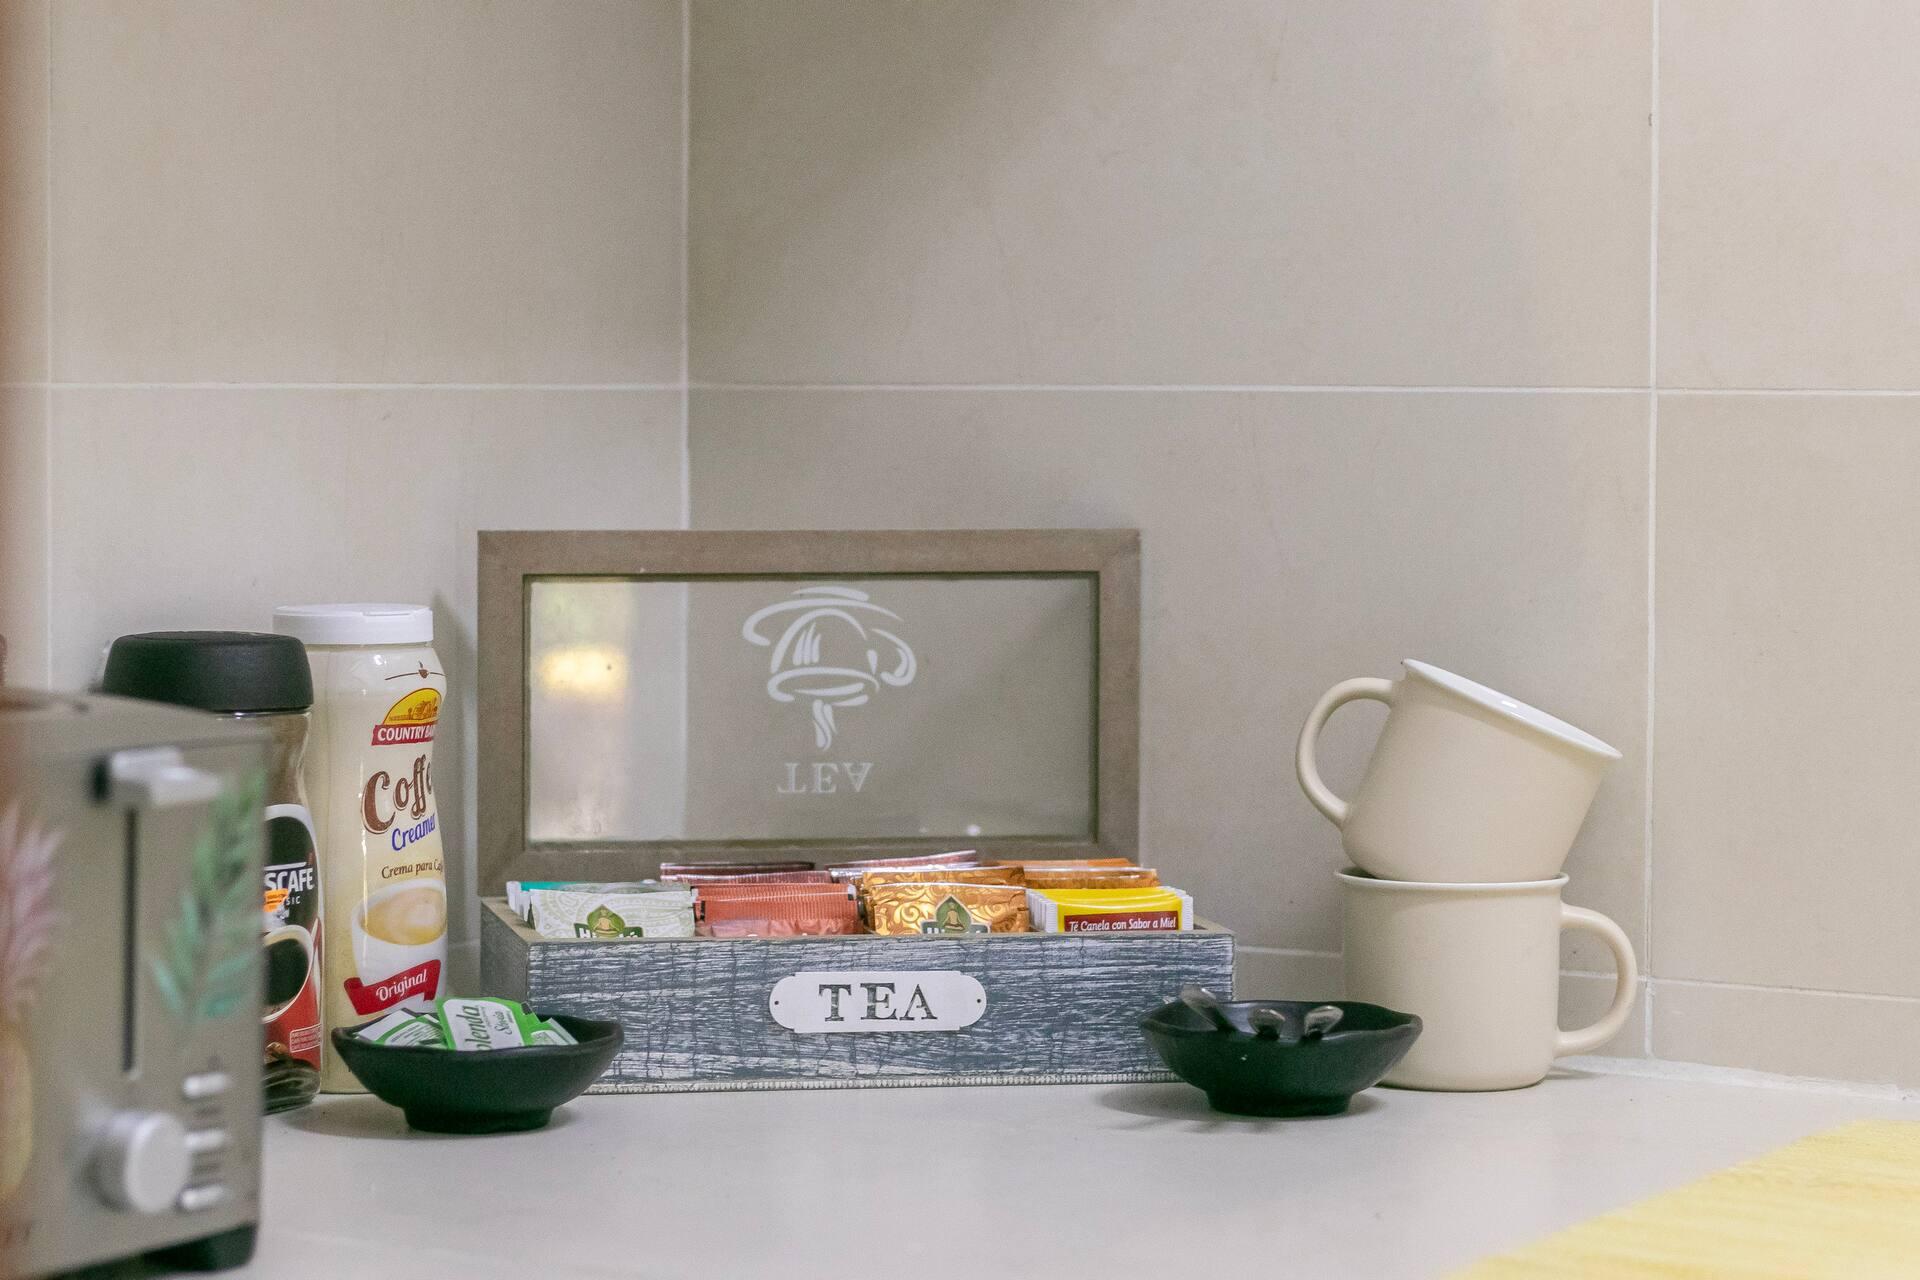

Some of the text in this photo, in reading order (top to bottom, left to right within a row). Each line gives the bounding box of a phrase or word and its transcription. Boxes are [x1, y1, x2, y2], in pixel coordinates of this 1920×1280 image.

[378, 725, 425, 741] COUNTRY
[264, 868, 315, 893] SCAFE
[381, 864, 413, 879] Crema
[415, 862, 432, 876] para
[1069, 916, 1177, 932] Té Canela con Sabor a Miel
[376, 968, 427, 1001] Original
[819, 982, 938, 1021] TEA
